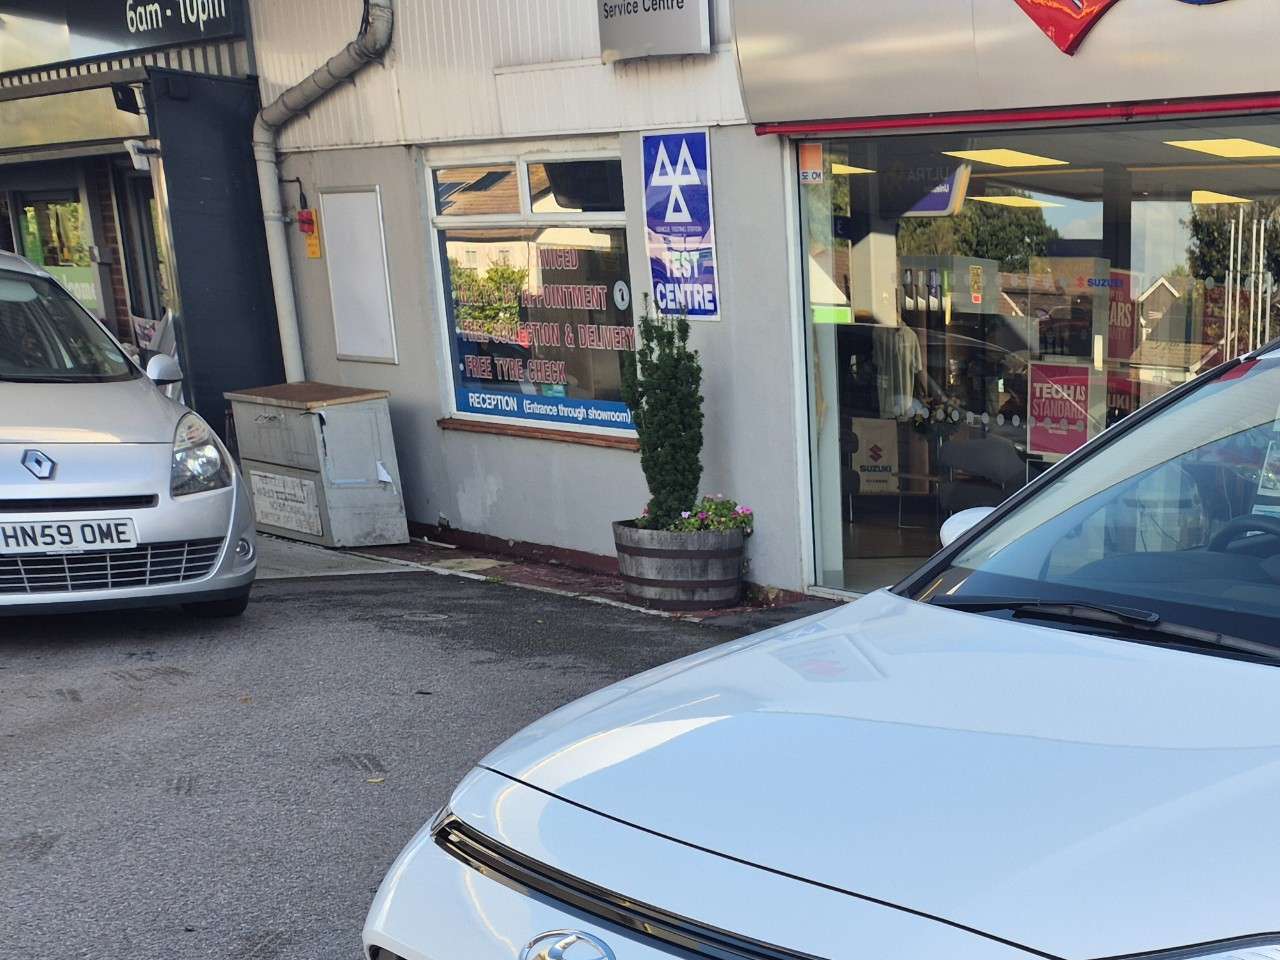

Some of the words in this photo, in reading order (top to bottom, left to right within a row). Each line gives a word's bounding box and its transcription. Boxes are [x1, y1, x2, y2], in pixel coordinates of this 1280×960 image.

[126, 0, 162, 33] 6am
[603, 0, 639, 19] Service
[661, 251, 700, 278] TEST
[521, 284, 608, 311] APPOINTMENT
[656, 282, 715, 310] CENTRE
[578, 324, 637, 351] DELIVERY
[464, 354, 493, 379] FREE
[494, 357, 525, 382] TYRE
[527, 359, 568, 384] CHECK
[1032, 382, 1074, 400] TECH
[1075, 384, 1087, 400] AS
[469, 392, 518, 411] RECEPTION
[523, 401, 558, 416] (Entrance
[558, 404, 588, 421] through
[588, 408, 632, 424] showroom)
[1031, 399, 1086, 419] STANDARD
[0, 524, 74, 548] HN59
[80, 522, 132, 544] OME
